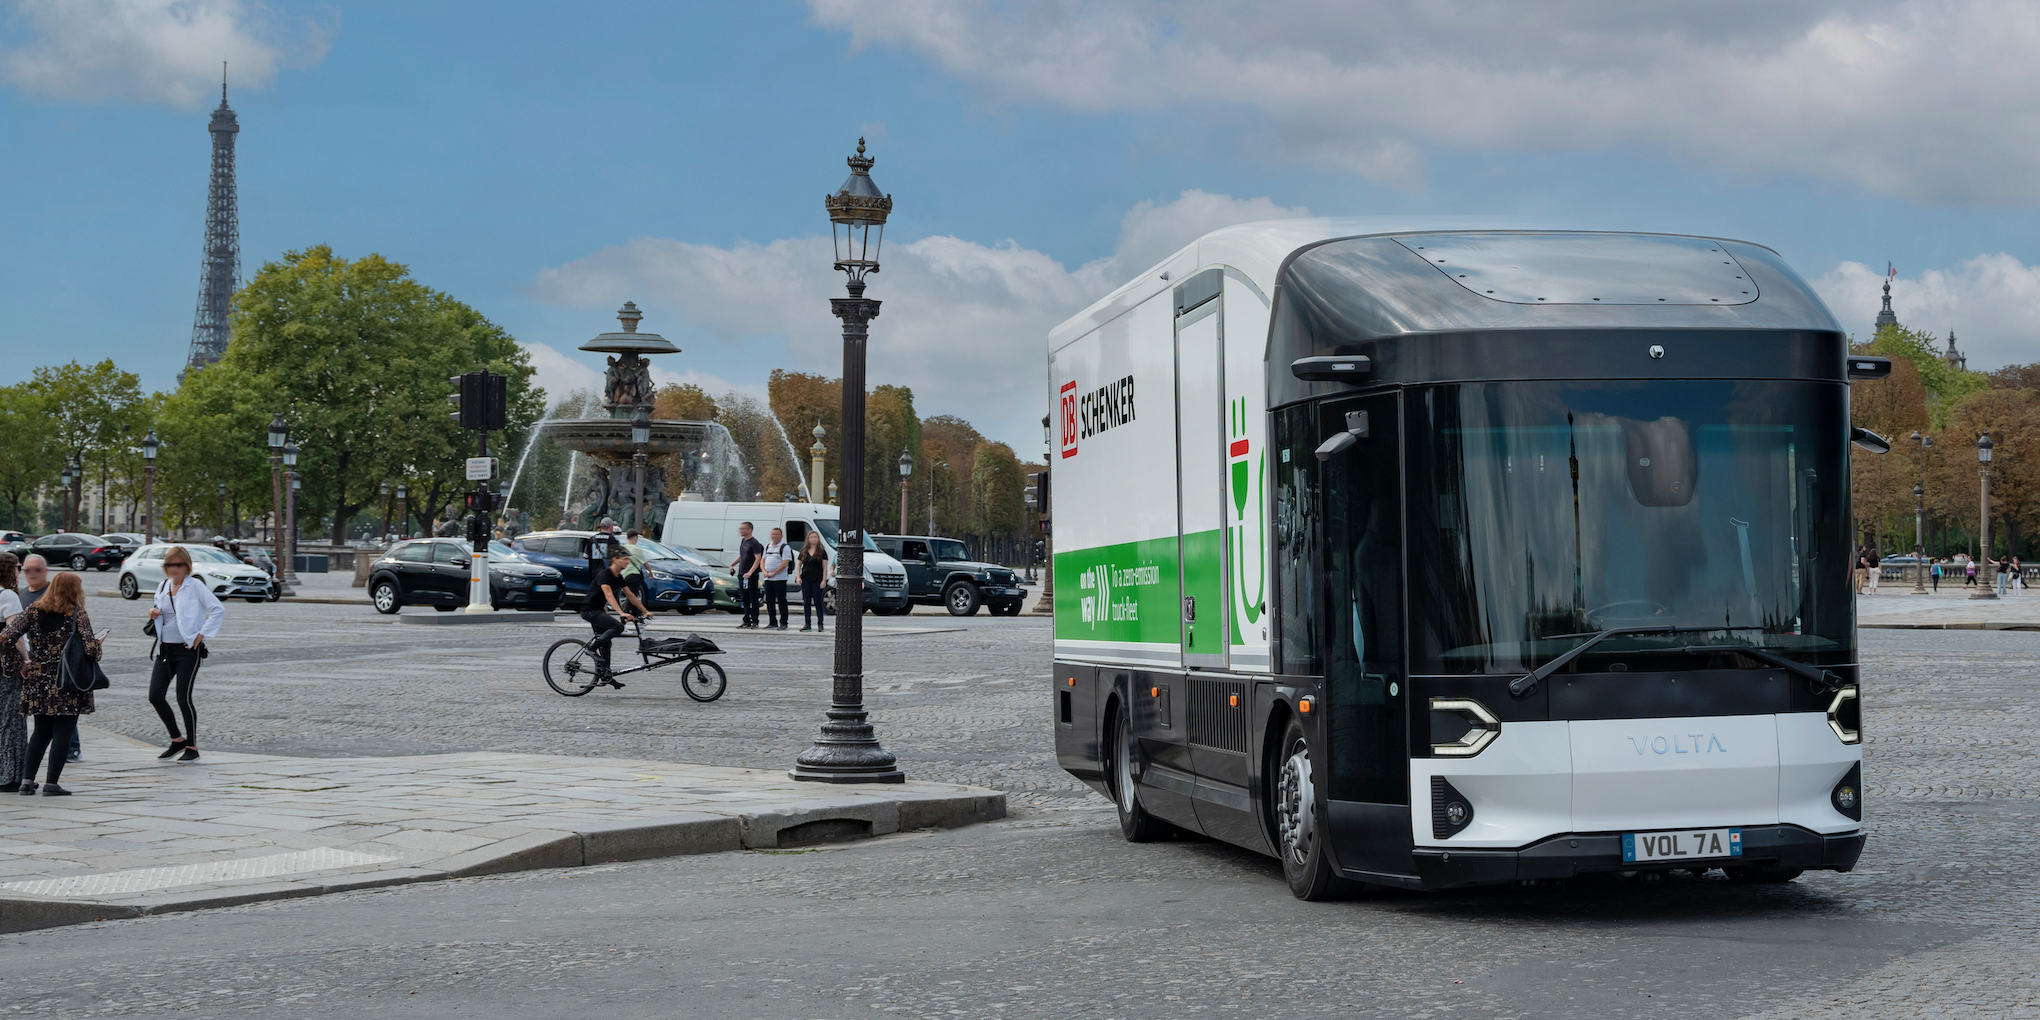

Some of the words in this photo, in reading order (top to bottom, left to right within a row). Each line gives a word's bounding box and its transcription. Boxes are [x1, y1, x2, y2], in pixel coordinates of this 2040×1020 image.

[1062, 394, 1076, 447] DB
[1080, 374, 1136, 440] SCHENKER
[1080, 572, 1087, 589] on
[1087, 566, 1095, 589] the
[1111, 564, 1118, 588] To
[1119, 569, 1122, 588] a
[1123, 560, 1160, 587] zero-emission
[1081, 596, 1096, 631] way
[1112, 595, 1139, 621] truck-fleet
[1627, 732, 1727, 756] VOLTA
[1642, 835, 1687, 857] VOL
[1693, 832, 1723, 855] 7A
